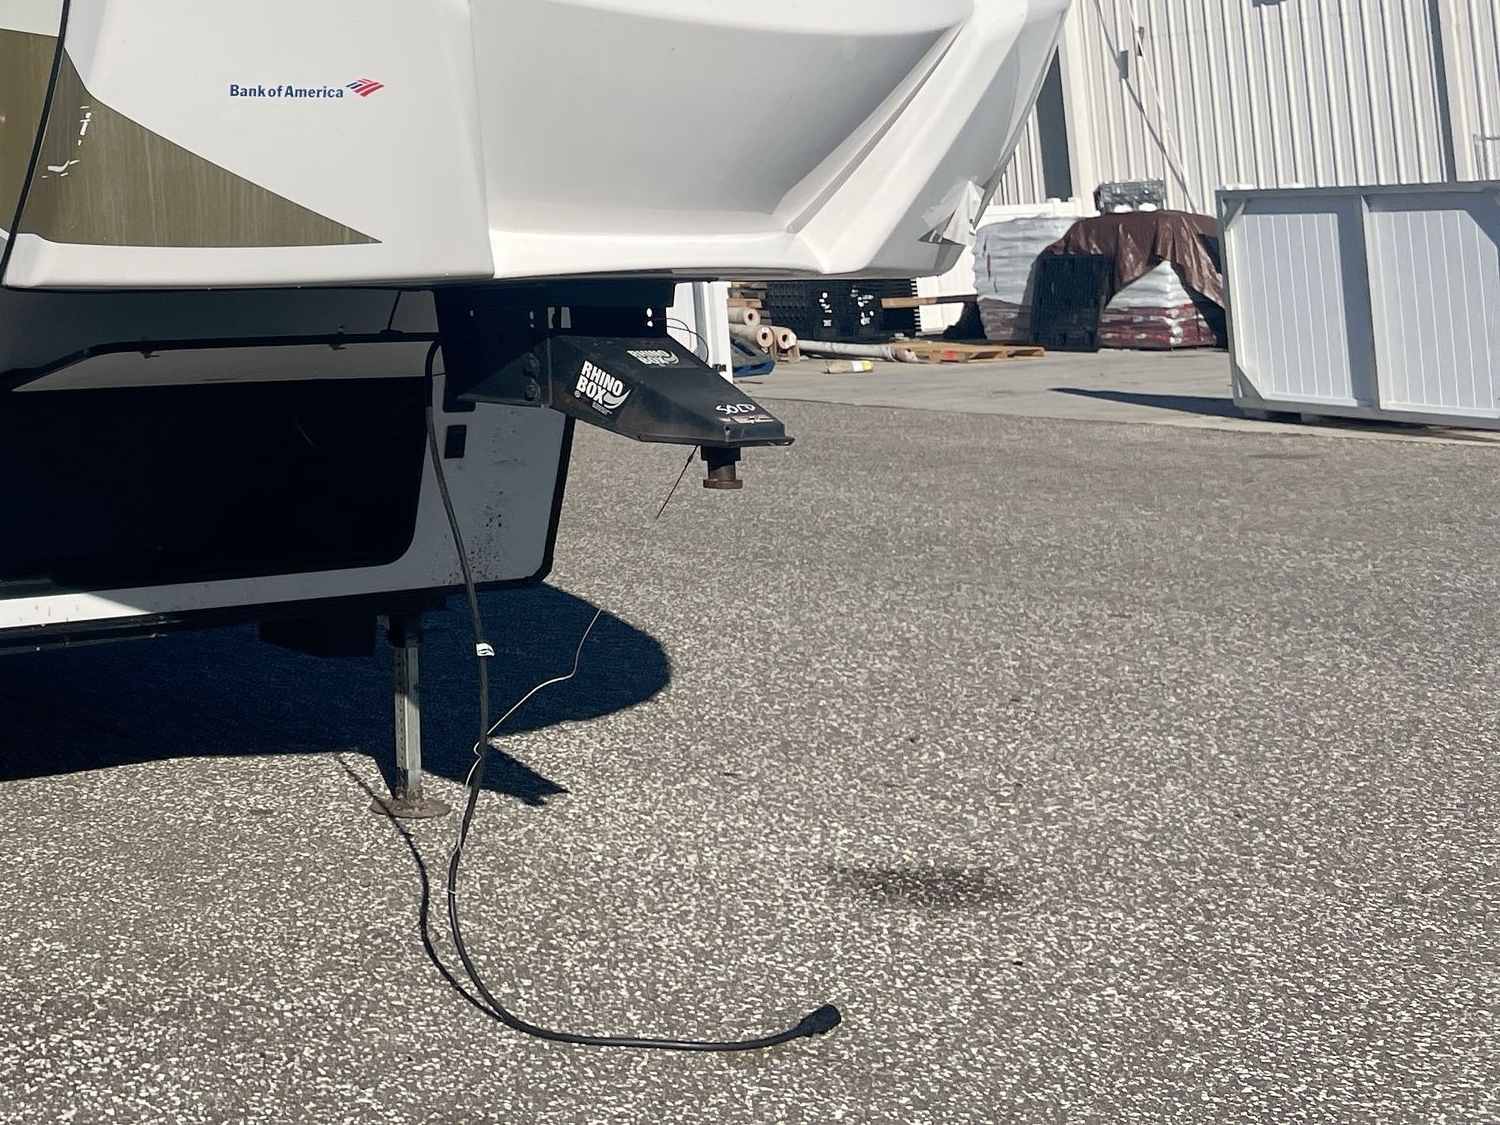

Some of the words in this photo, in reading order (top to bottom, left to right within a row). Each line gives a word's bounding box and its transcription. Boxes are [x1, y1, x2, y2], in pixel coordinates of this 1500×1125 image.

[229, 84, 266, 97] Bank
[268, 85, 283, 98] of
[284, 85, 344, 98] America
[576, 374, 608, 405] BOX
[581, 360, 624, 397] RHINO
